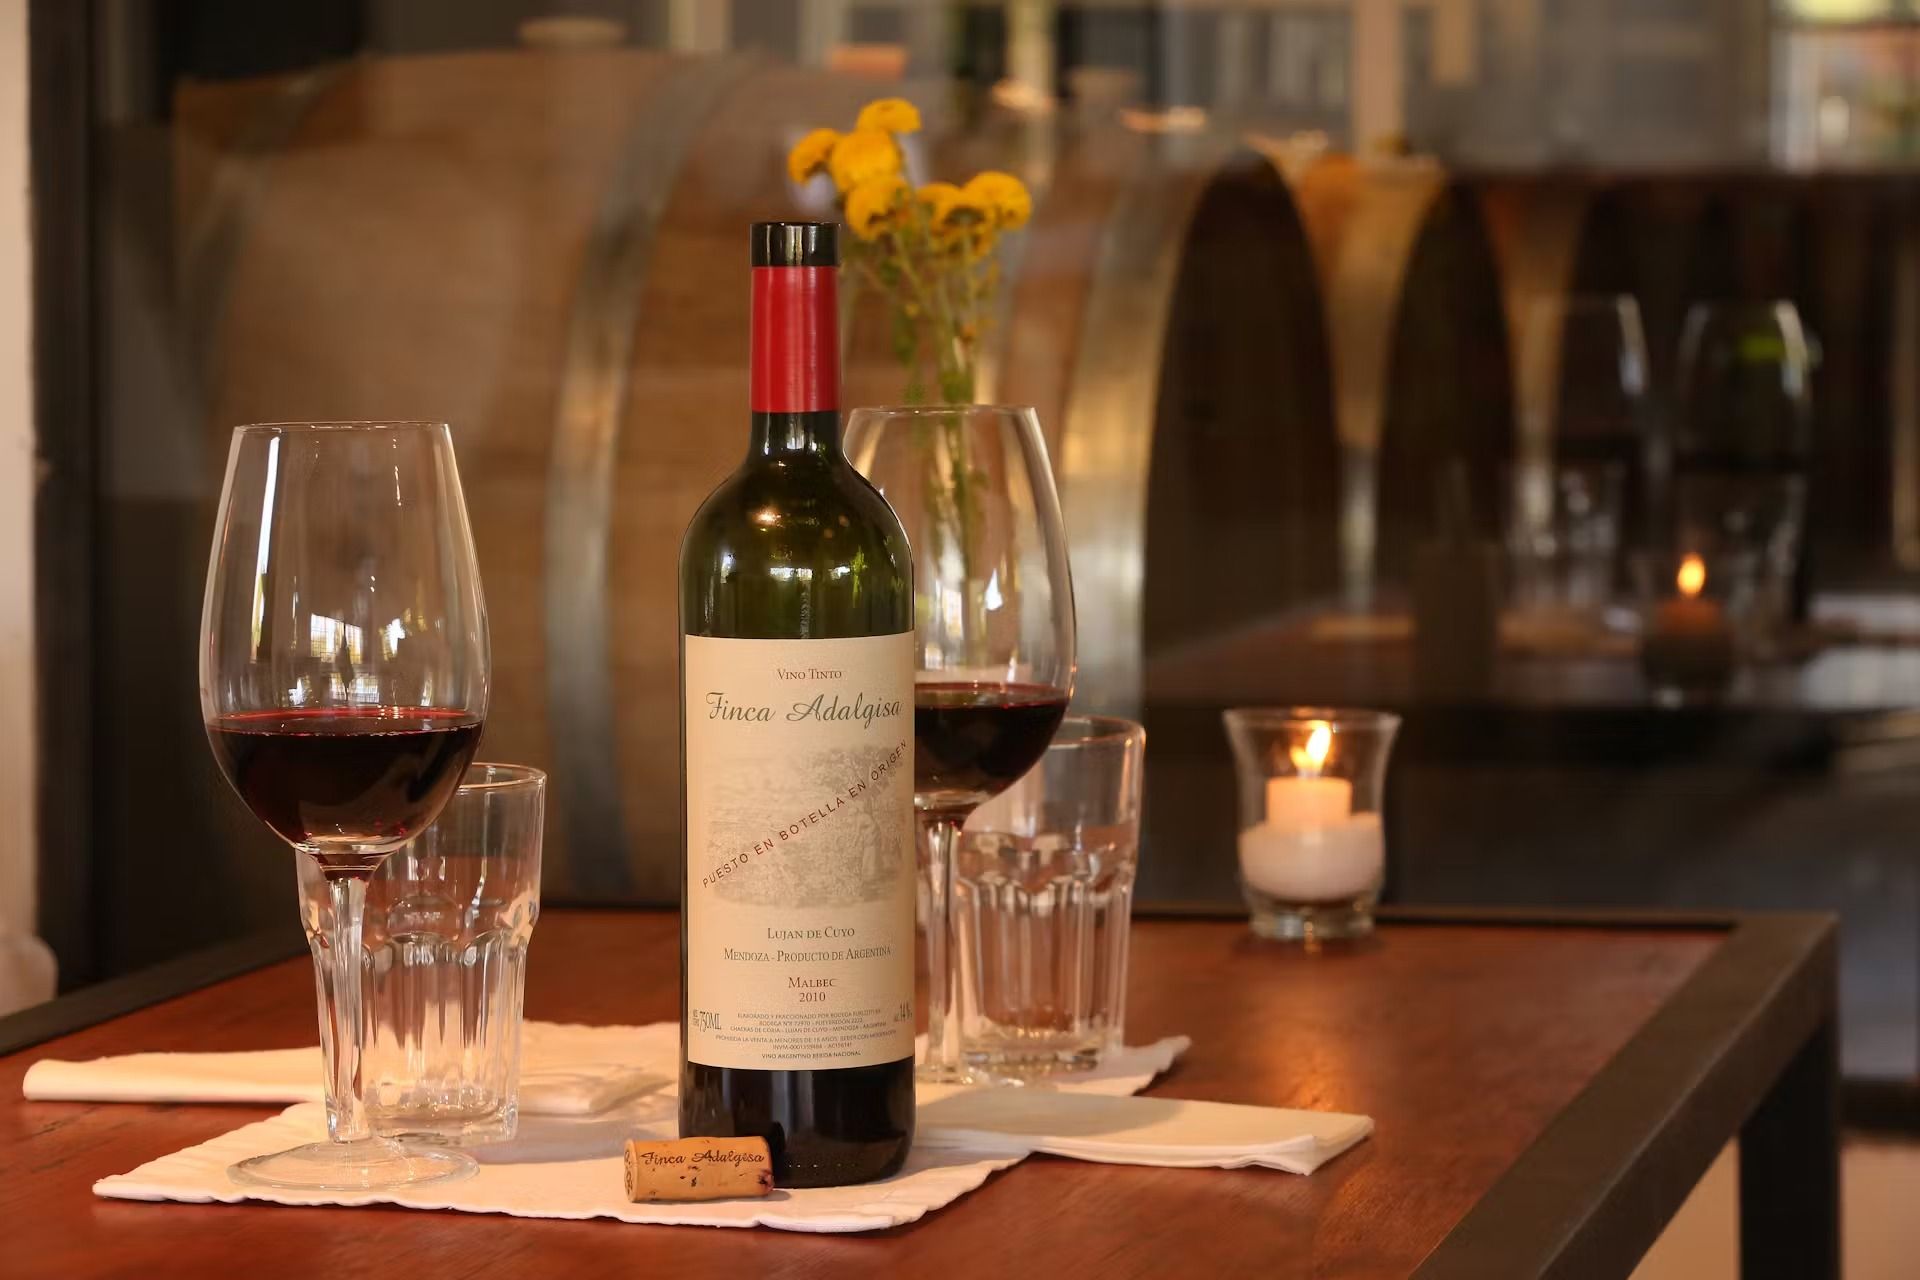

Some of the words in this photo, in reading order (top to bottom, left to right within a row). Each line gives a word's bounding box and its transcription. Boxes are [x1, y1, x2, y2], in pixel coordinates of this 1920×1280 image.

[777, 668, 806, 680] VINO
[808, 668, 842, 680] TINTO
[705, 691, 776, 722] Finca
[785, 692, 903, 730] Adalgisa
[702, 853, 749, 888] PUESTO
[754, 838, 774, 855] EN
[779, 797, 845, 841] BOTELLA
[848, 780, 866, 798] EN
[870, 739, 906, 780] ORIGEN
[806, 929, 822, 939] DE
[824, 926, 855, 938] CUYO
[723, 947, 770, 961] MENDOZA
[776, 949, 830, 962] PRODUCTO
[831, 951, 844, 961] DE
[788, 976, 837, 989] MALBEC
[799, 991, 826, 1002] 2010
[640, 1151, 687, 1166] Finca
[691, 1149, 765, 1167] Adalgisa
